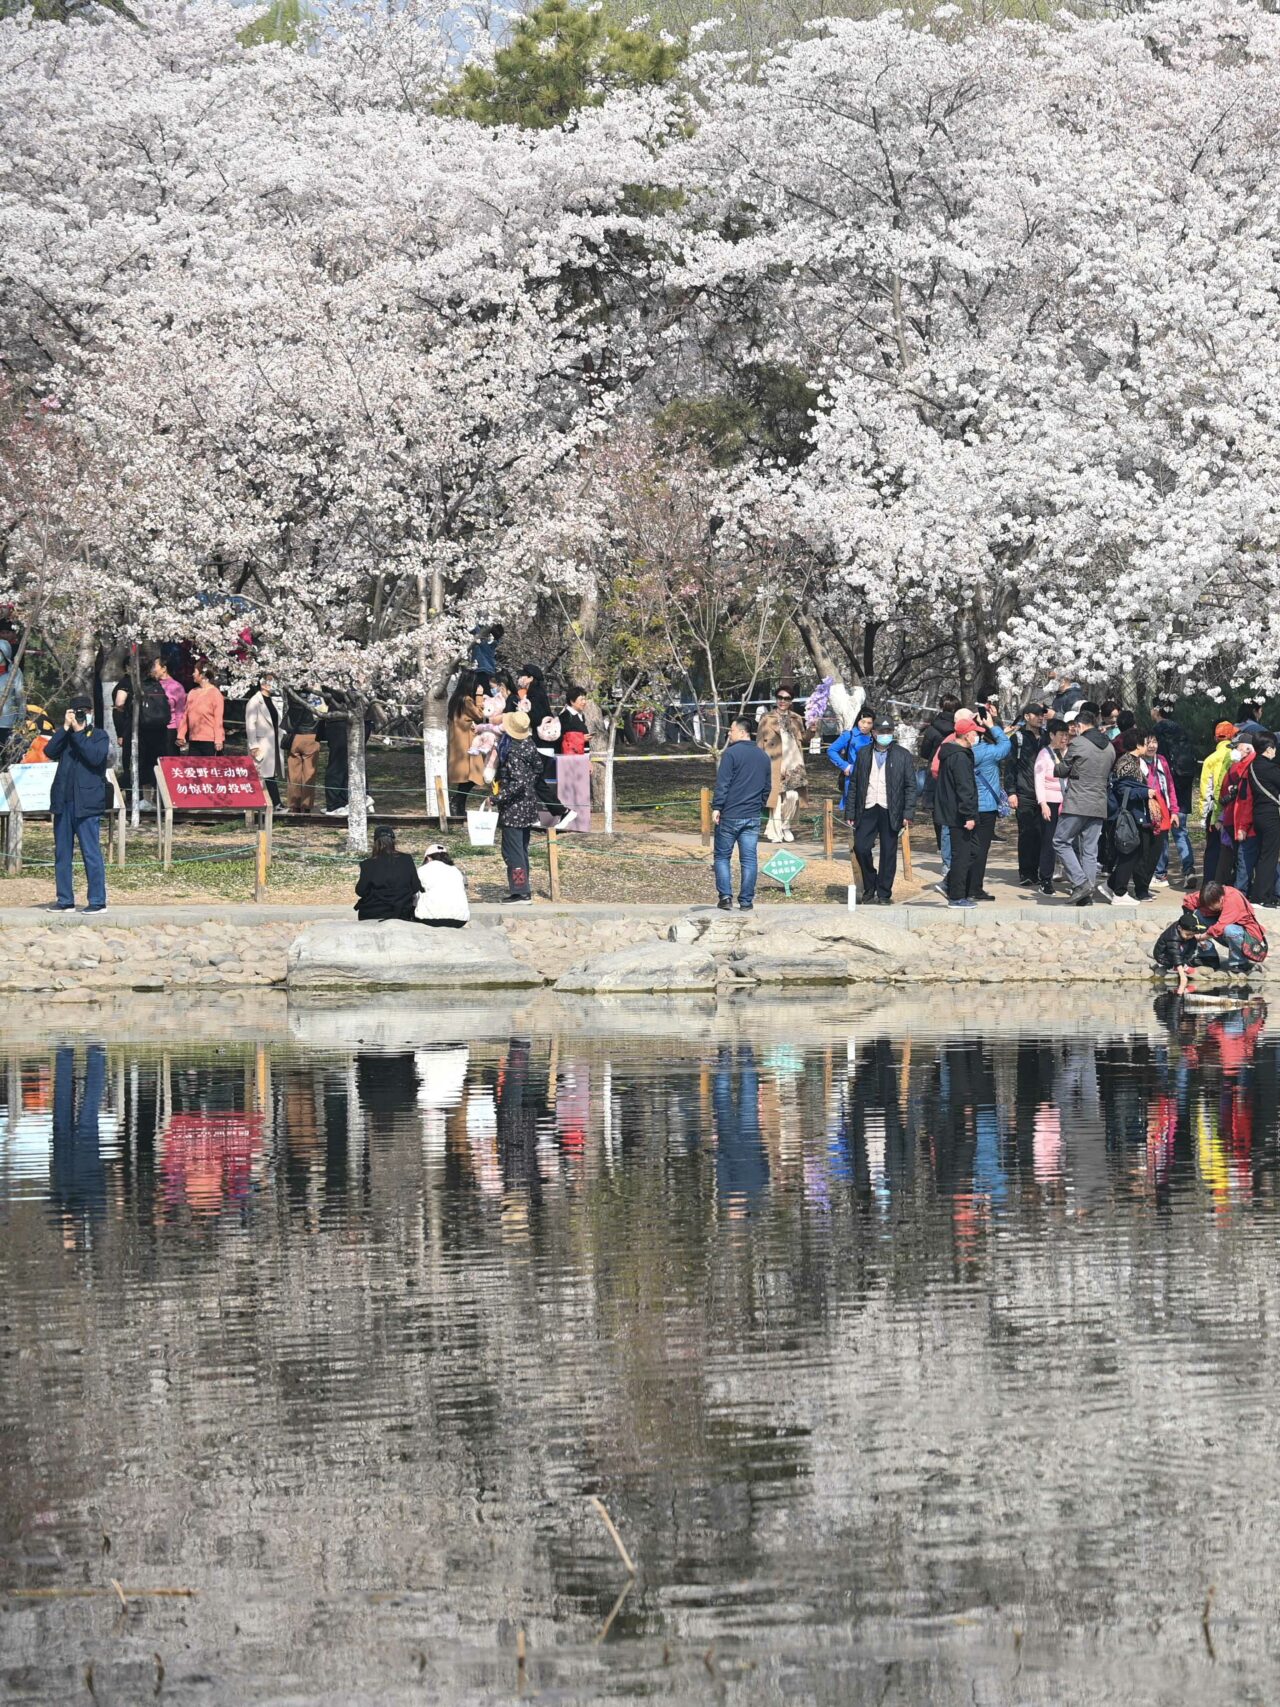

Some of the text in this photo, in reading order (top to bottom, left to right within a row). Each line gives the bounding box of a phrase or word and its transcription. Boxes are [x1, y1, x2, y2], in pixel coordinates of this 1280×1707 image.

[171, 767, 249, 779] 关爱野生动物
[176, 783, 255, 795] 勿惊扰勿投喂
